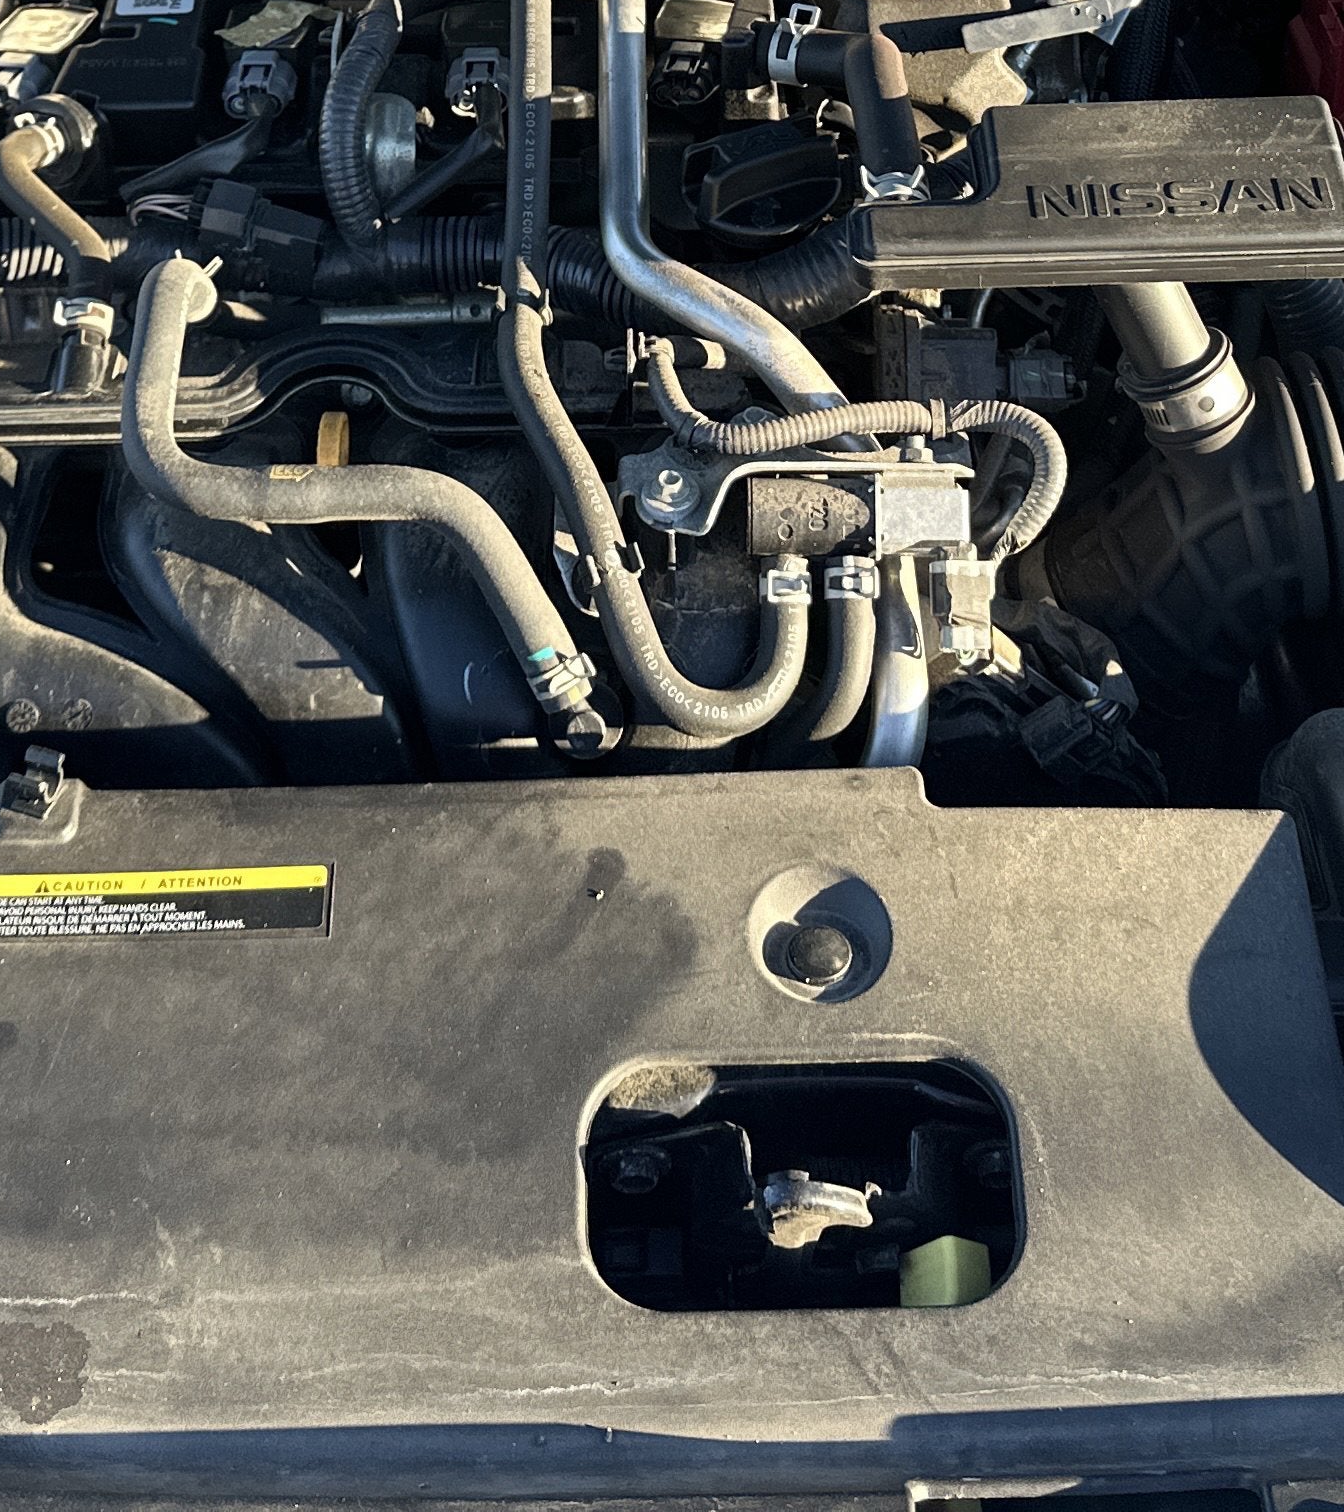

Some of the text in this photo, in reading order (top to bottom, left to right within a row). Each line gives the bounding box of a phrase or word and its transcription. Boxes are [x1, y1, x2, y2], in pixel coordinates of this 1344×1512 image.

[1028, 175, 1337, 220] NISSAN
[52, 879, 124, 892] CAUTION
[158, 875, 243, 889] ATTENTION
[9, 897, 28, 906] CAN
[28, 896, 53, 906] START
[54, 896, 65, 905] AT
[65, 896, 84, 905] ANY
[24, 905, 67, 915] PERSONAL
[99, 904, 119, 914] KEEP
[120, 904, 149, 913] HANDS
[33, 914, 66, 925] RISQUE
[67, 914, 80, 924] DE
[140, 912, 163, 922] TOUT
[18, 925, 47, 935] TOUTE
[95, 924, 109, 934] NE
[109, 923, 127, 933] PAS
[128, 922, 141, 933] EN
[142, 921, 196, 933] APPROCHER
[197, 920, 213, 930] LES
